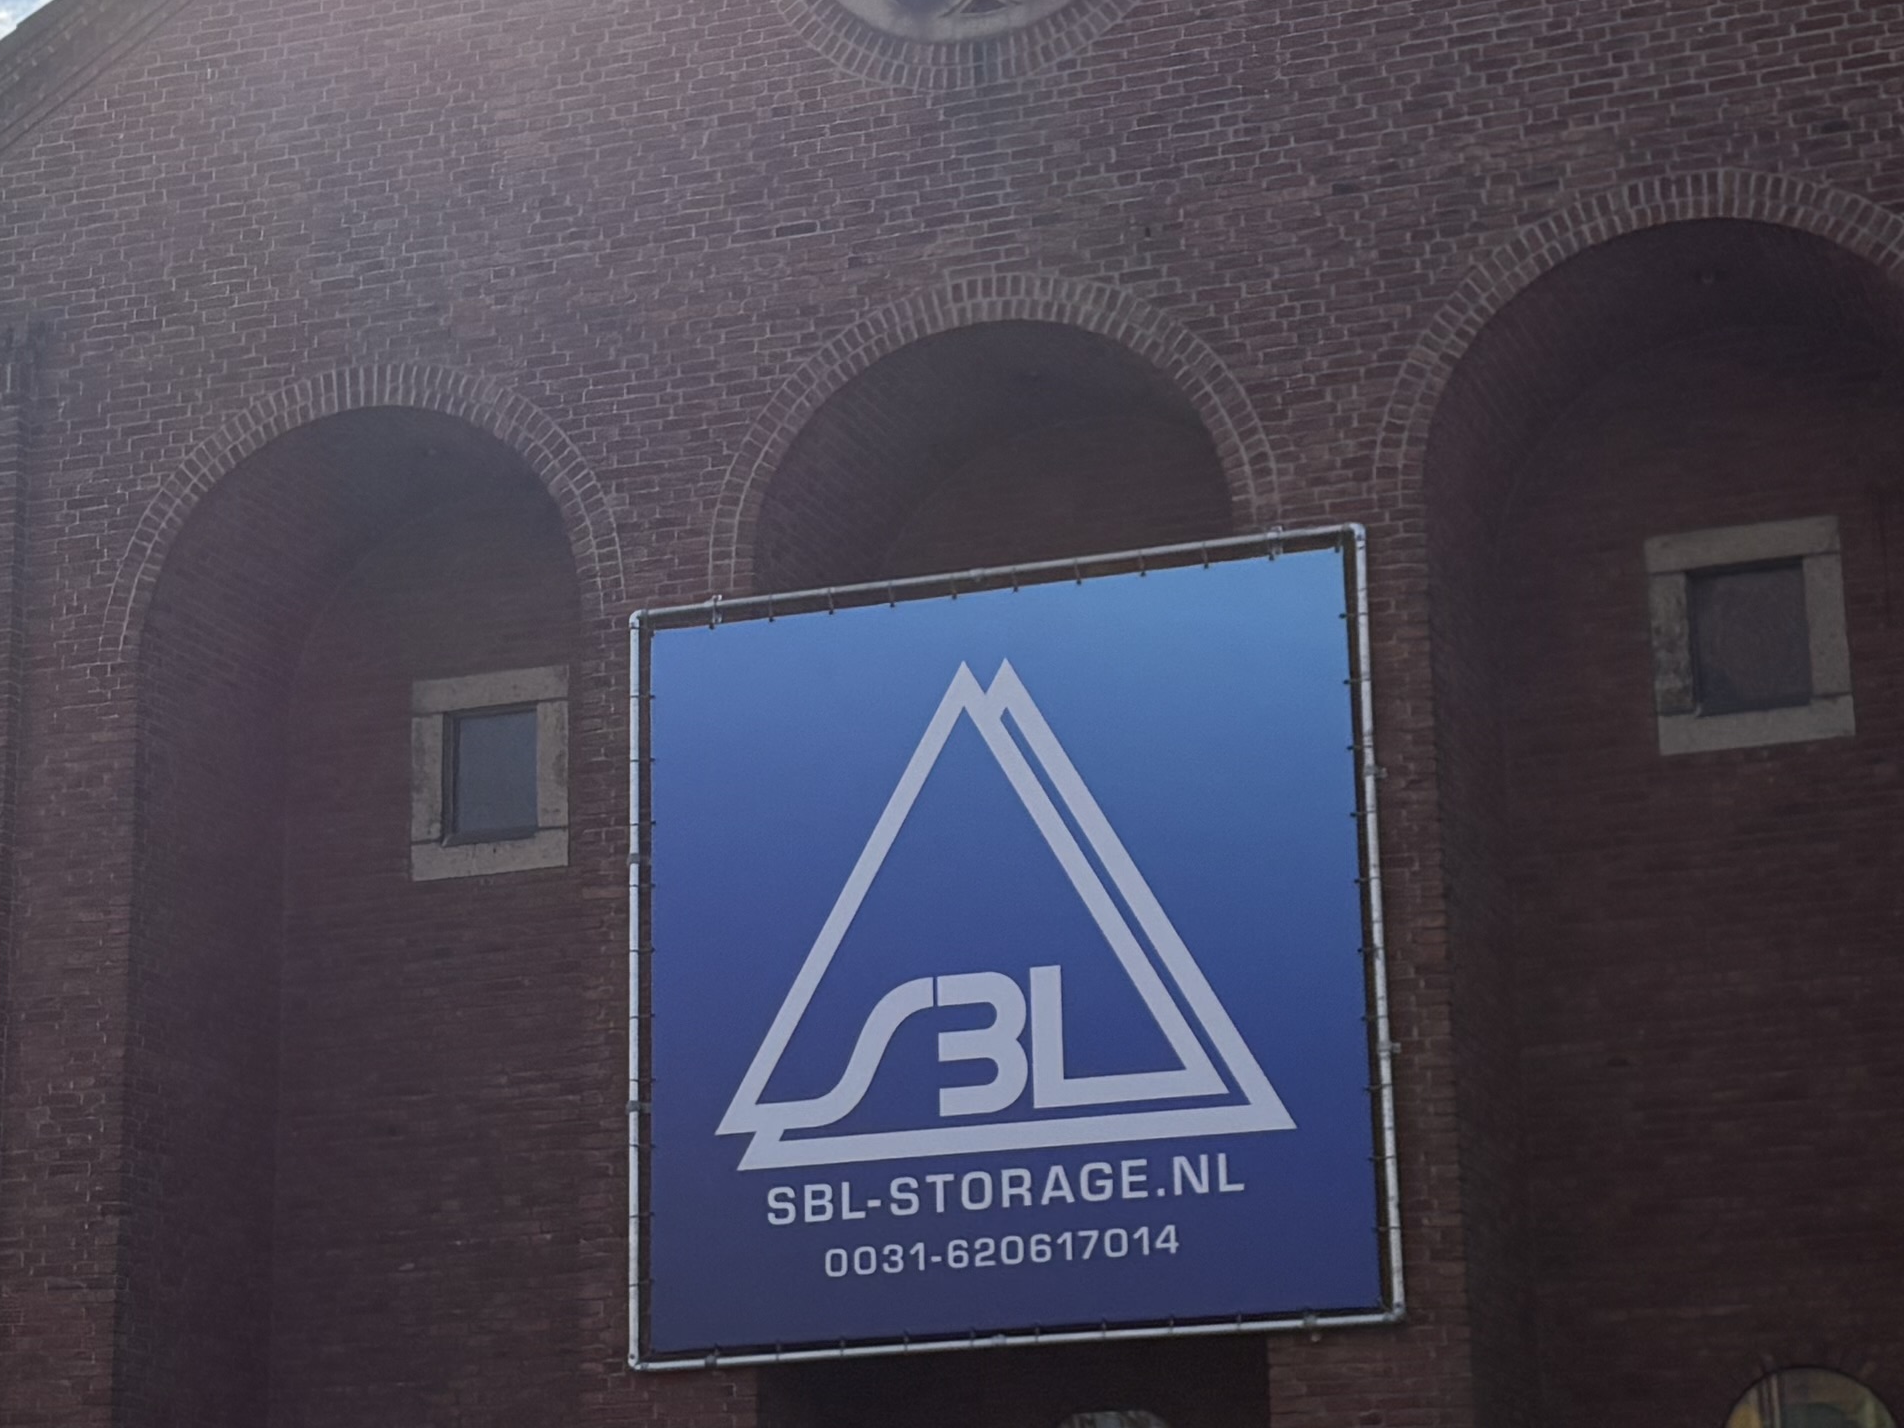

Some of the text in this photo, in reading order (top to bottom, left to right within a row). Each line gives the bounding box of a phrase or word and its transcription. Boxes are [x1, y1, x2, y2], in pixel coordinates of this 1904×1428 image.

[748, 965, 1230, 1130] SBL
[766, 1152, 1246, 1227] SBL-STORAGE.NL
[824, 1224, 1181, 1278] 0031-620617014
